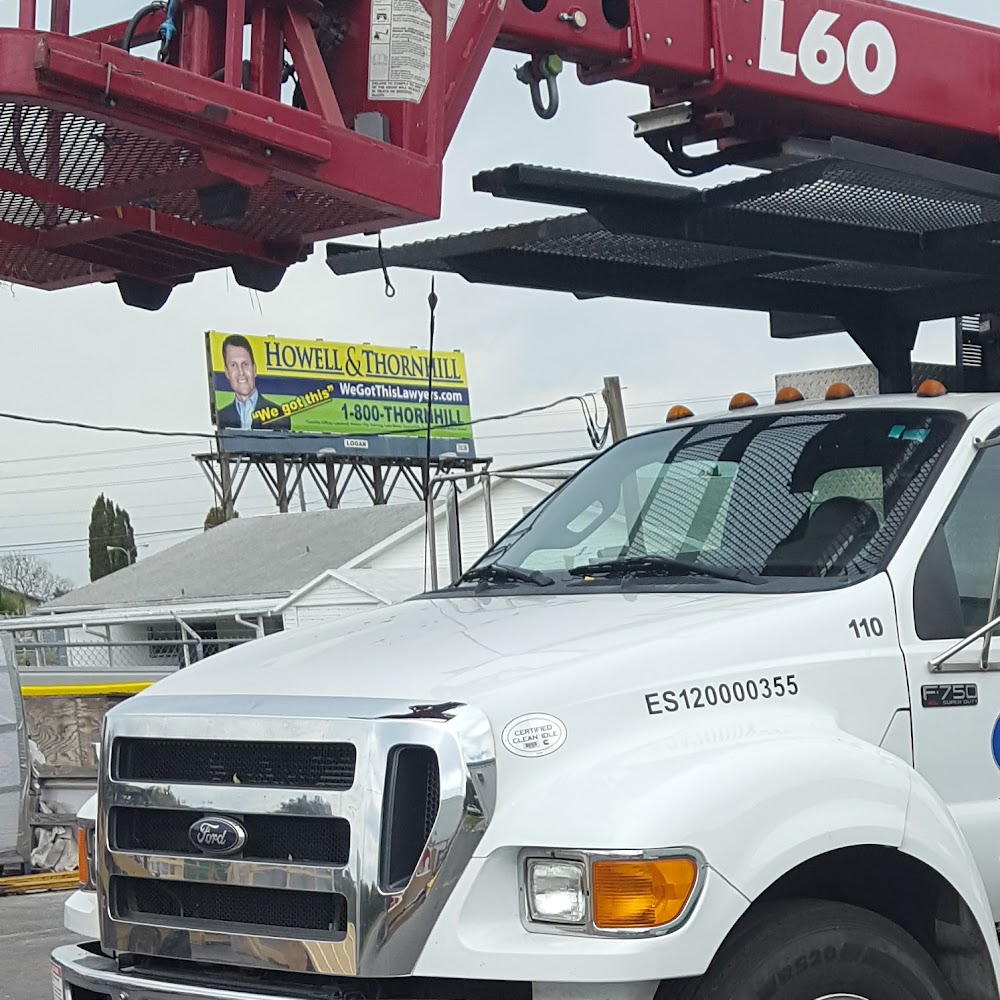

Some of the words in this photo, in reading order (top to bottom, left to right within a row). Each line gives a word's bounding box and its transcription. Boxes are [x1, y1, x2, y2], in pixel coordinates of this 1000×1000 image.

[759, 0, 897, 95] L60
[264, 341, 342, 371] HOWELL
[345, 346, 364, 377] &
[362, 349, 461, 380] THORNHILL
[339, 382, 463, 403] WeGotThisLawyers.com
[281, 396, 303, 416] got
[341, 403, 463, 426] 1-800-THORNHILL
[346, 440, 367, 448] LOGAN
[849, 617, 884, 638] 110
[644, 674, 799, 715] ES120000355
[512, 734, 538, 743] CLEAN
[541, 731, 557, 739] IDLE
[514, 725, 552, 736] CERTIFIED
[196, 822, 228, 845] Ford
